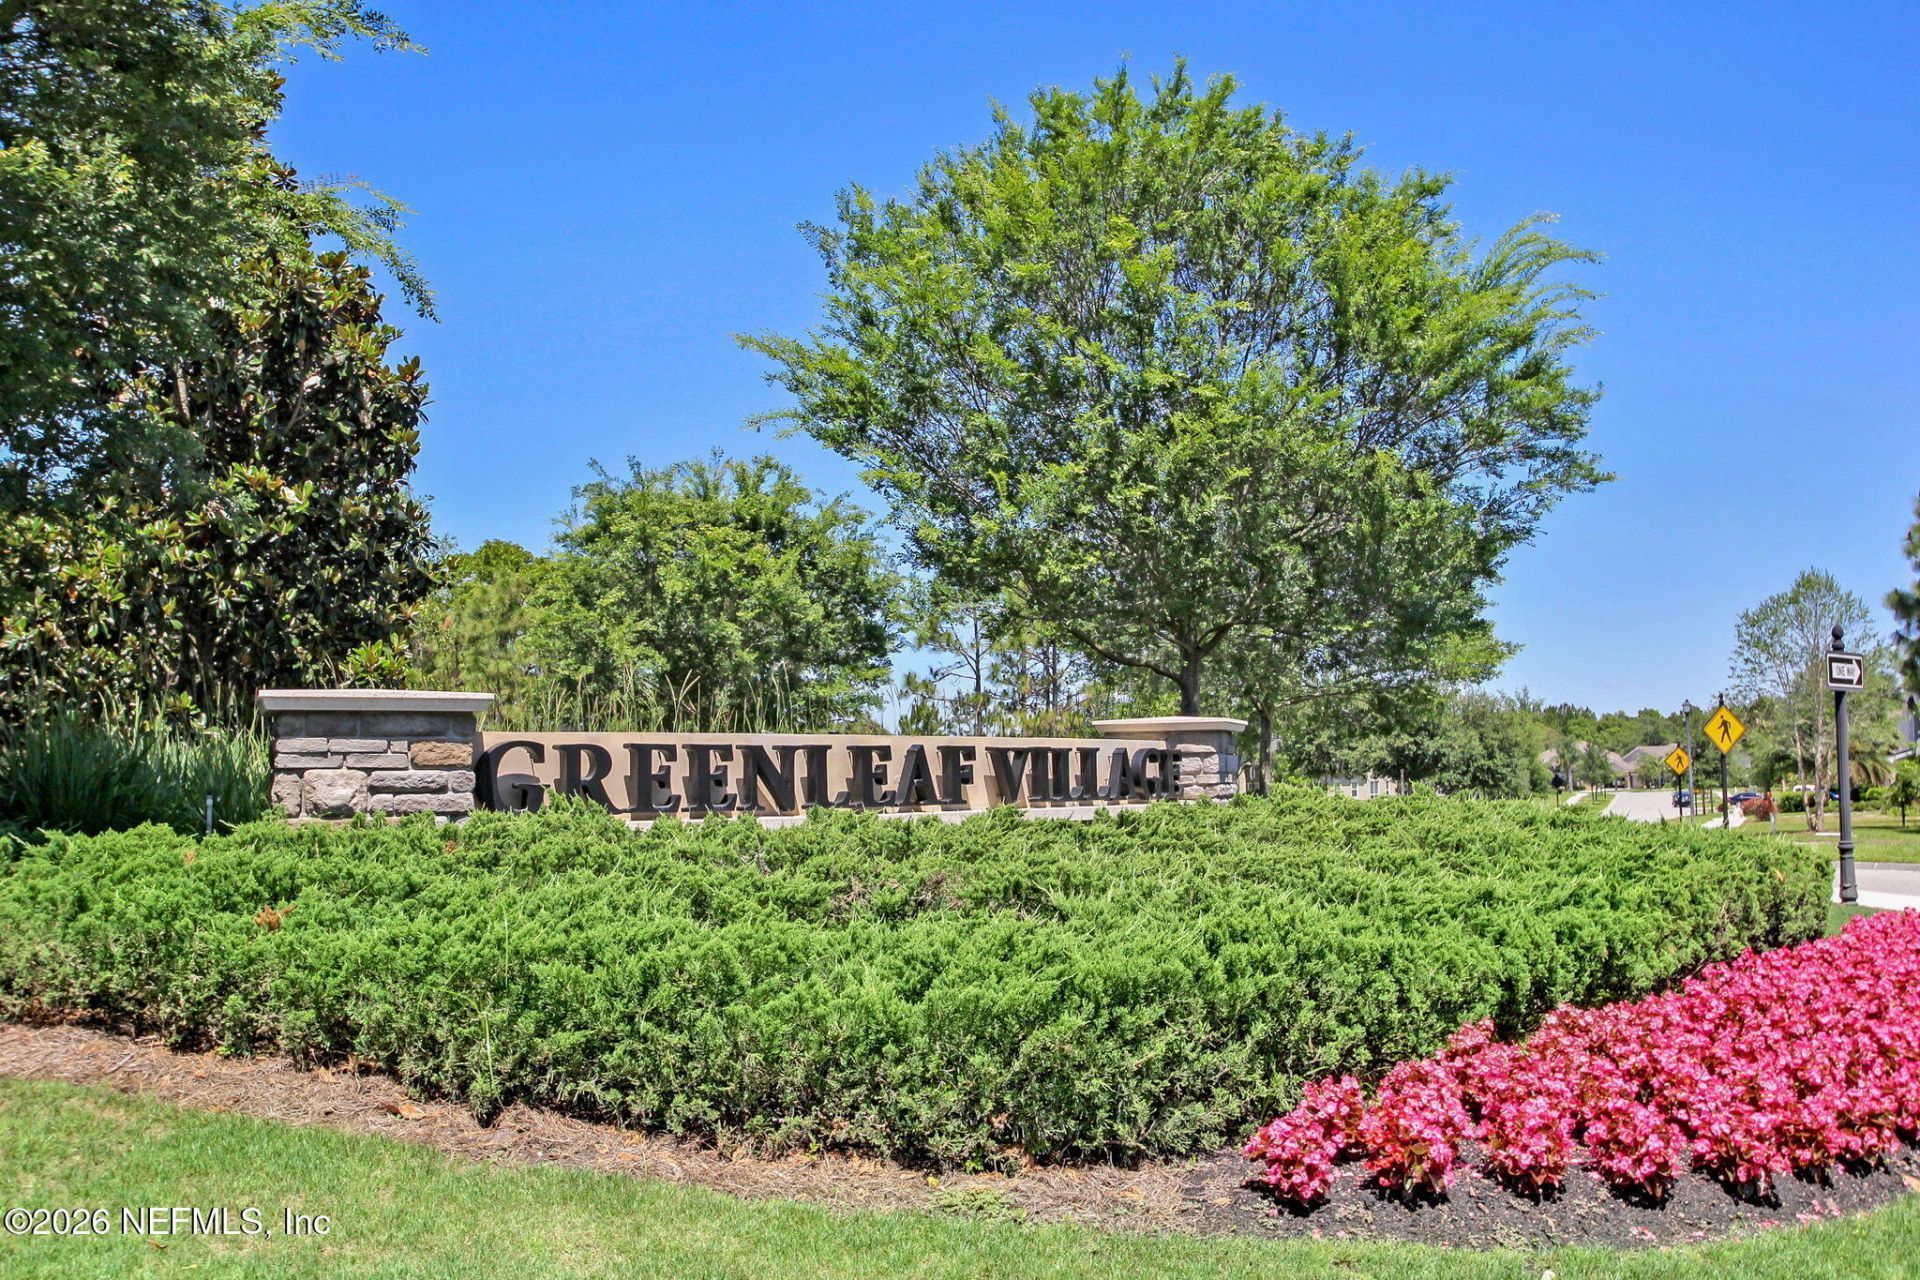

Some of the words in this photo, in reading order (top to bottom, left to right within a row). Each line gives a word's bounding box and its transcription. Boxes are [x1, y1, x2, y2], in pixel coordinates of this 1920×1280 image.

[1835, 665, 1845, 677] ONE
[475, 740, 976, 814] GREENLEAF
[986, 746, 1182, 804] VILLAGE
